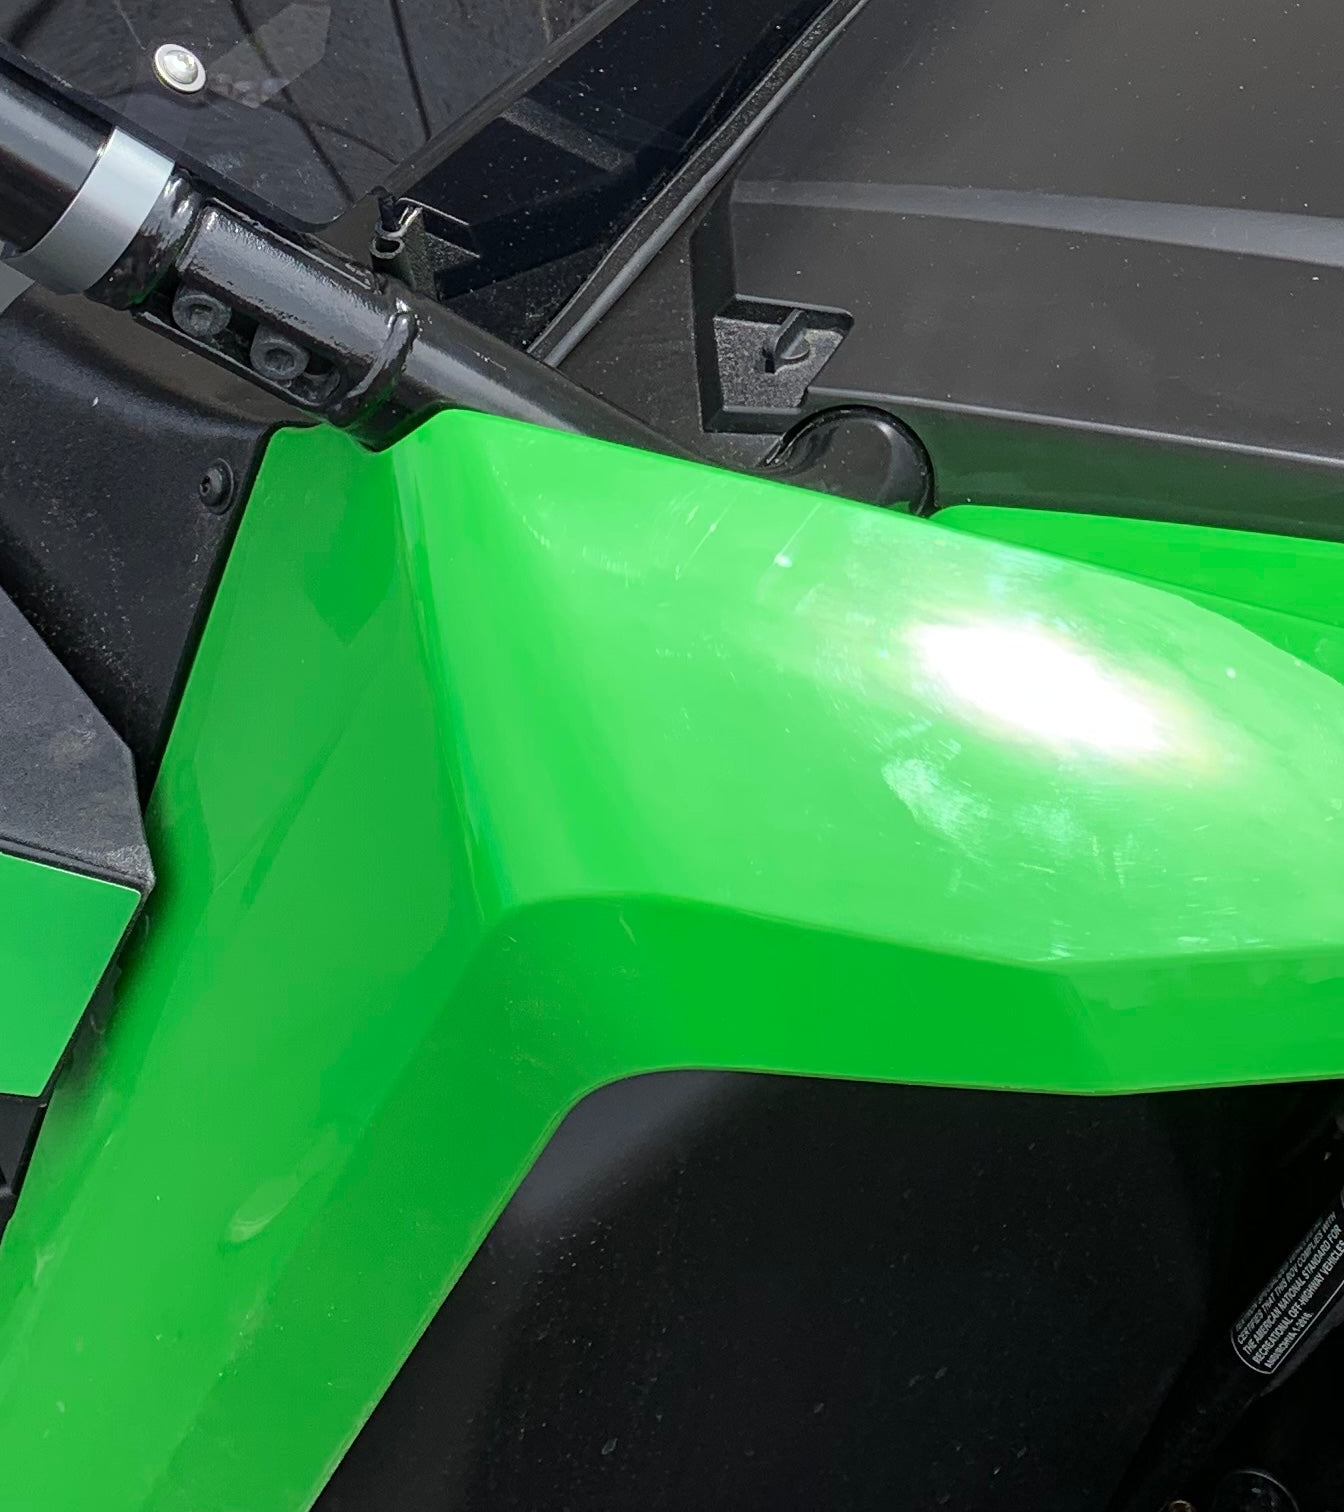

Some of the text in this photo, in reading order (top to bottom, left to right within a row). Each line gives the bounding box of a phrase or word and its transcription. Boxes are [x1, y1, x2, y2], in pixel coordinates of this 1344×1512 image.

[1242, 1224, 1341, 1354] THE AMERICAN NATIONAL STANDARD FOR
[1251, 1313, 1293, 1364] RECREATIONAL
[1287, 1271, 1324, 1318] OFF-HIGHWAY
[1260, 1292, 1275, 1312] THAT
[1273, 1277, 1287, 1296] THIS
[1295, 1230, 1322, 1267] COMPLIES
